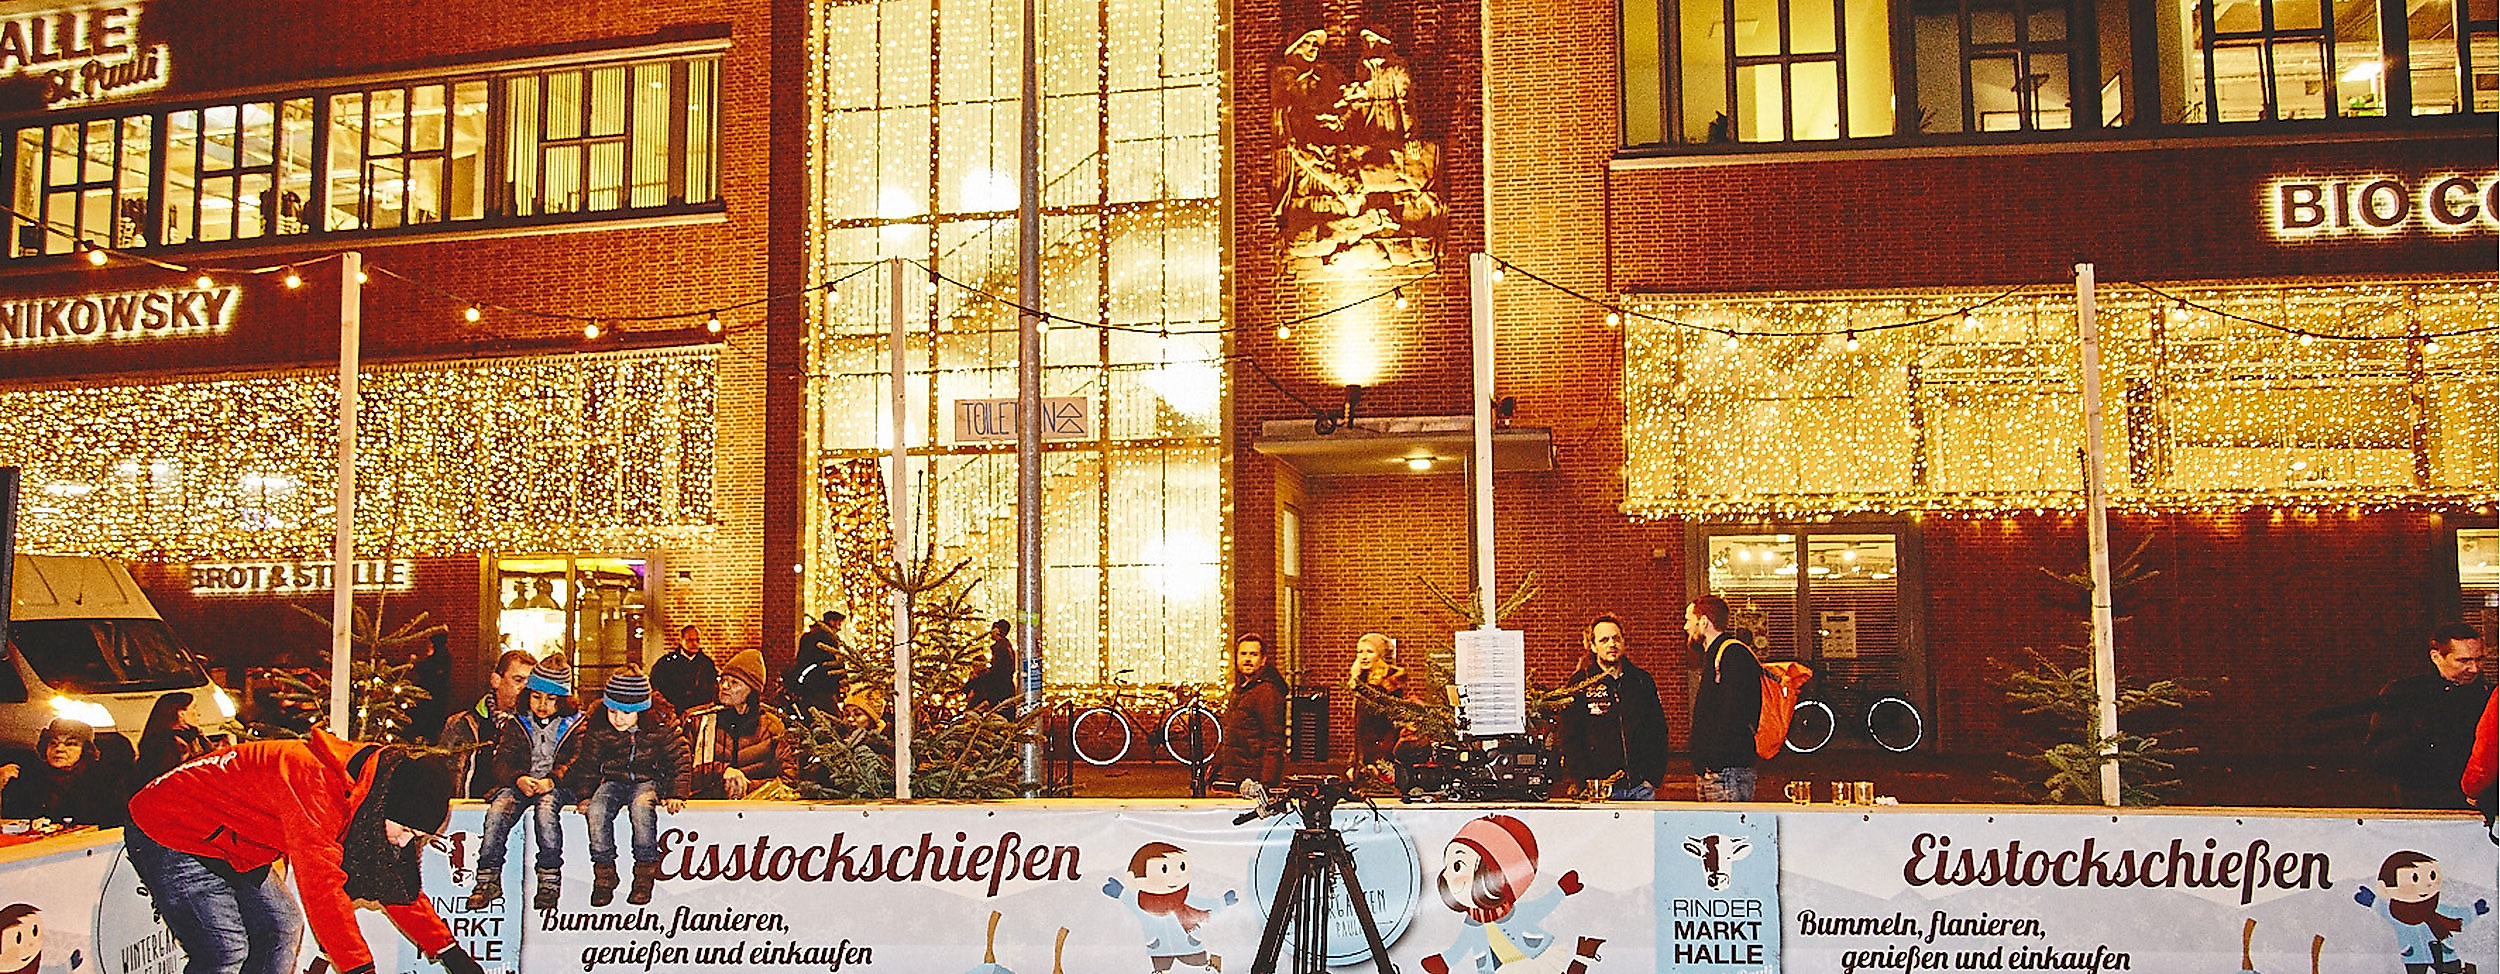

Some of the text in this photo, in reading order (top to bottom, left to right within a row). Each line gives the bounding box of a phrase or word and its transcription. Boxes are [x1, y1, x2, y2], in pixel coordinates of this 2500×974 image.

[2281, 177, 2500, 229] BIO C
[0, 288, 232, 339] NIKOWSKY
[961, 401, 1056, 436] TOILETN
[189, 566, 266, 589] BROT
[656, 829, 1082, 898] Eisstockschießen
[1903, 832, 2334, 905] Eisstockschießen
[540, 906, 789, 939] Bummeln, flanieren,
[1673, 899, 1762, 918] RINDER
[1674, 921, 1762, 940] MARKT
[1797, 909, 2047, 944] Bummeln, flanieren,
[581, 939, 872, 973] genießen und einkaufen
[1674, 943, 1764, 964] HALLE
[1841, 944, 2131, 974] genießen und einkaufen
